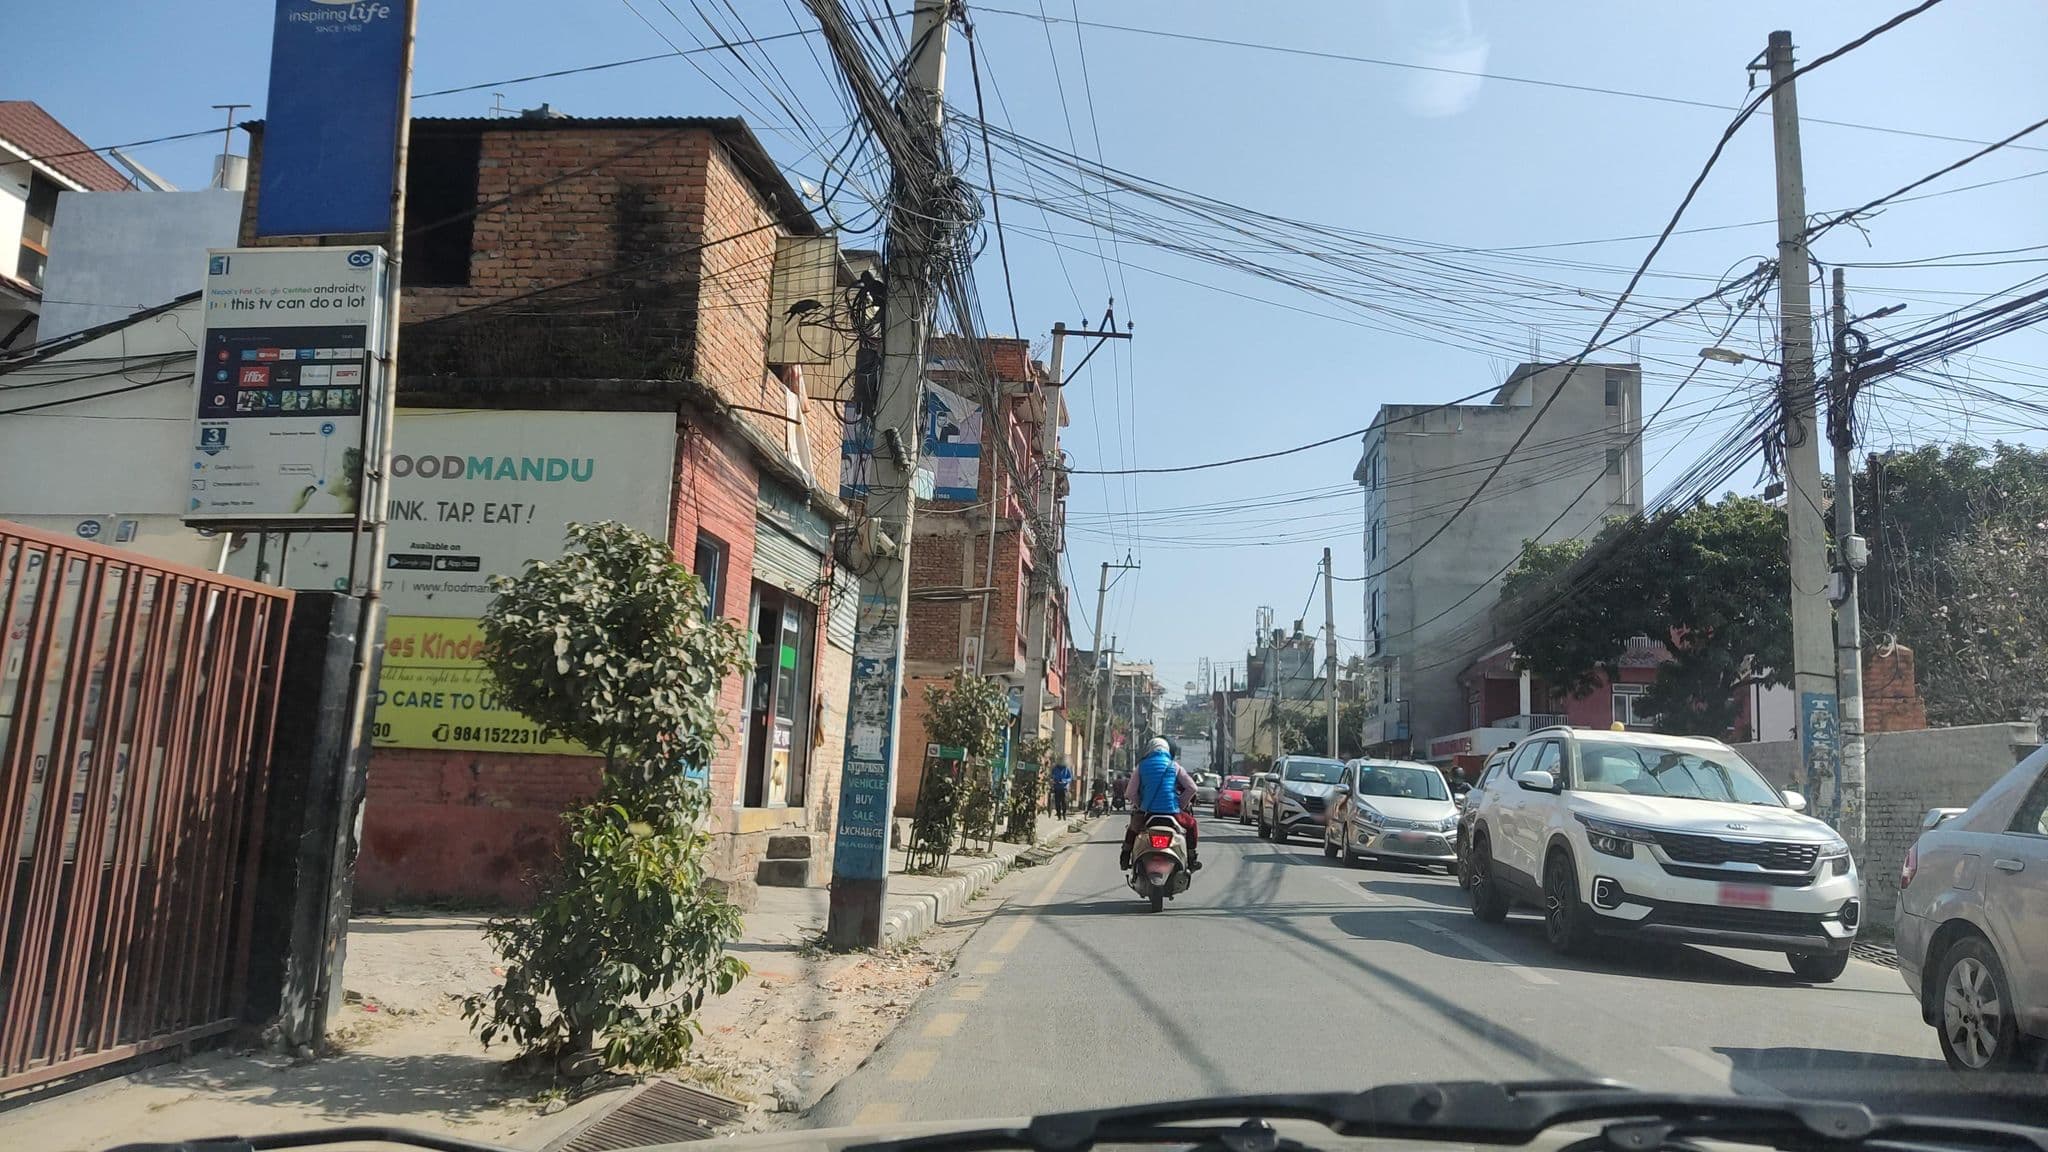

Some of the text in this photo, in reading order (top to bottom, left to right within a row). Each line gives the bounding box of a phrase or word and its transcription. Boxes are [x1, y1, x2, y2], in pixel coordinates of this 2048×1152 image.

[289, 2, 390, 23] inspiring life
[349, 253, 372, 265] CG
[231, 298, 255, 310] this
[259, 298, 272, 309] tv
[277, 299, 304, 309] can
[310, 297, 329, 308] do
[333, 299, 342, 308] a
[347, 296, 365, 307] lot
[243, 370, 266, 383] iflix
[208, 429, 219, 441] 3
[390, 454, 594, 482] OODMANDU
[388, 500, 427, 521] INK.
[78, 523, 99, 536] CG
[410, 542, 448, 550] Available
[383, 581, 392, 590] 77
[384, 636, 414, 658] es
[393, 691, 444, 708] CARE
[451, 694, 475, 709] TO
[453, 726, 548, 744] 9841522310
[849, 777, 884, 790] VEHICLE
[855, 794, 873, 805] BUY
[852, 810, 874, 821] SALE
[840, 825, 884, 838] EXCHANGE
